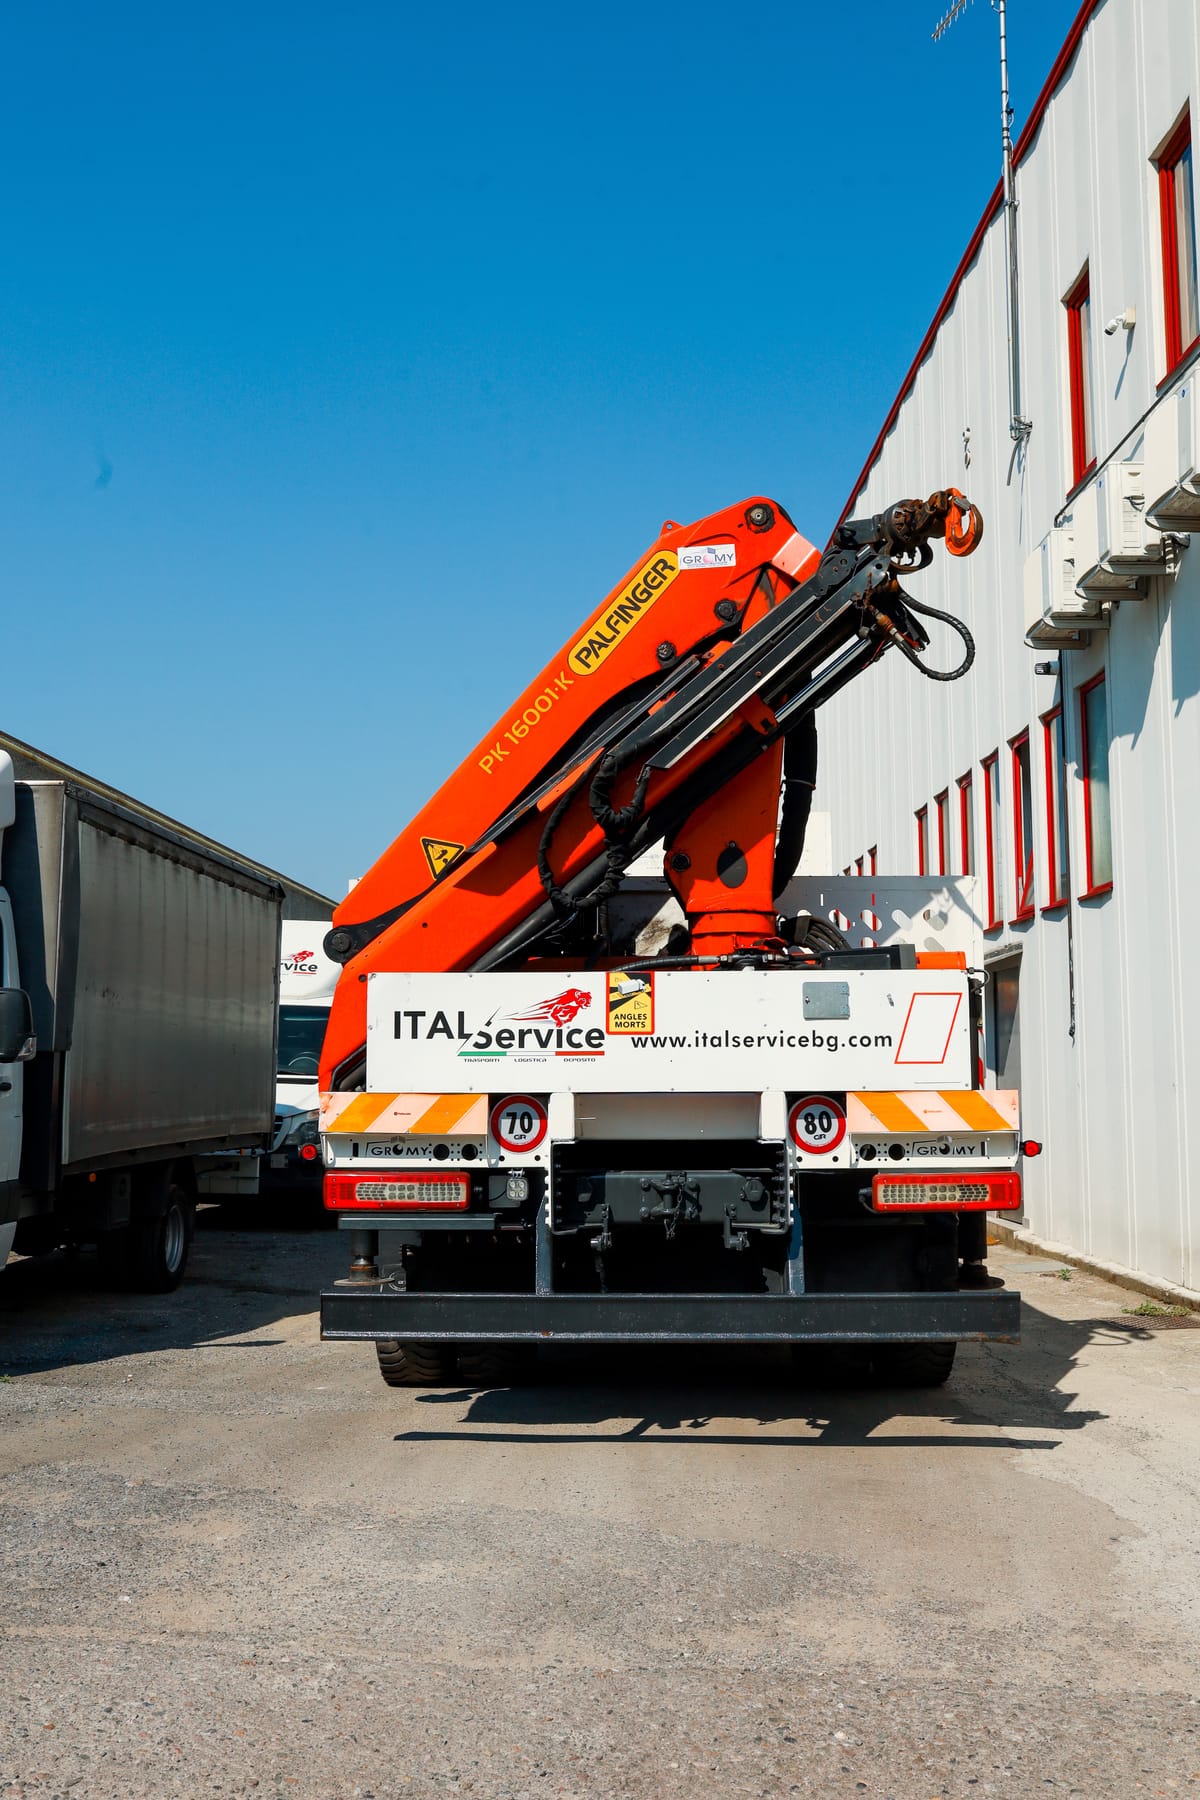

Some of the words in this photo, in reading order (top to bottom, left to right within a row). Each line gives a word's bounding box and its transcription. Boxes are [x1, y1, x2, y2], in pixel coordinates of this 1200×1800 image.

[574, 558, 676, 670] PALFINGER
[478, 742, 511, 775] PK
[614, 1013, 648, 1021] ANGLES
[615, 1021, 646, 1029] MORTS
[631, 1030, 893, 1052] www.italservicebg.com
[506, 1111, 533, 1134] 70
[804, 1110, 832, 1135] 80
[371, 1144, 429, 1156] GROMY
[917, 1143, 976, 1155] GROMY
